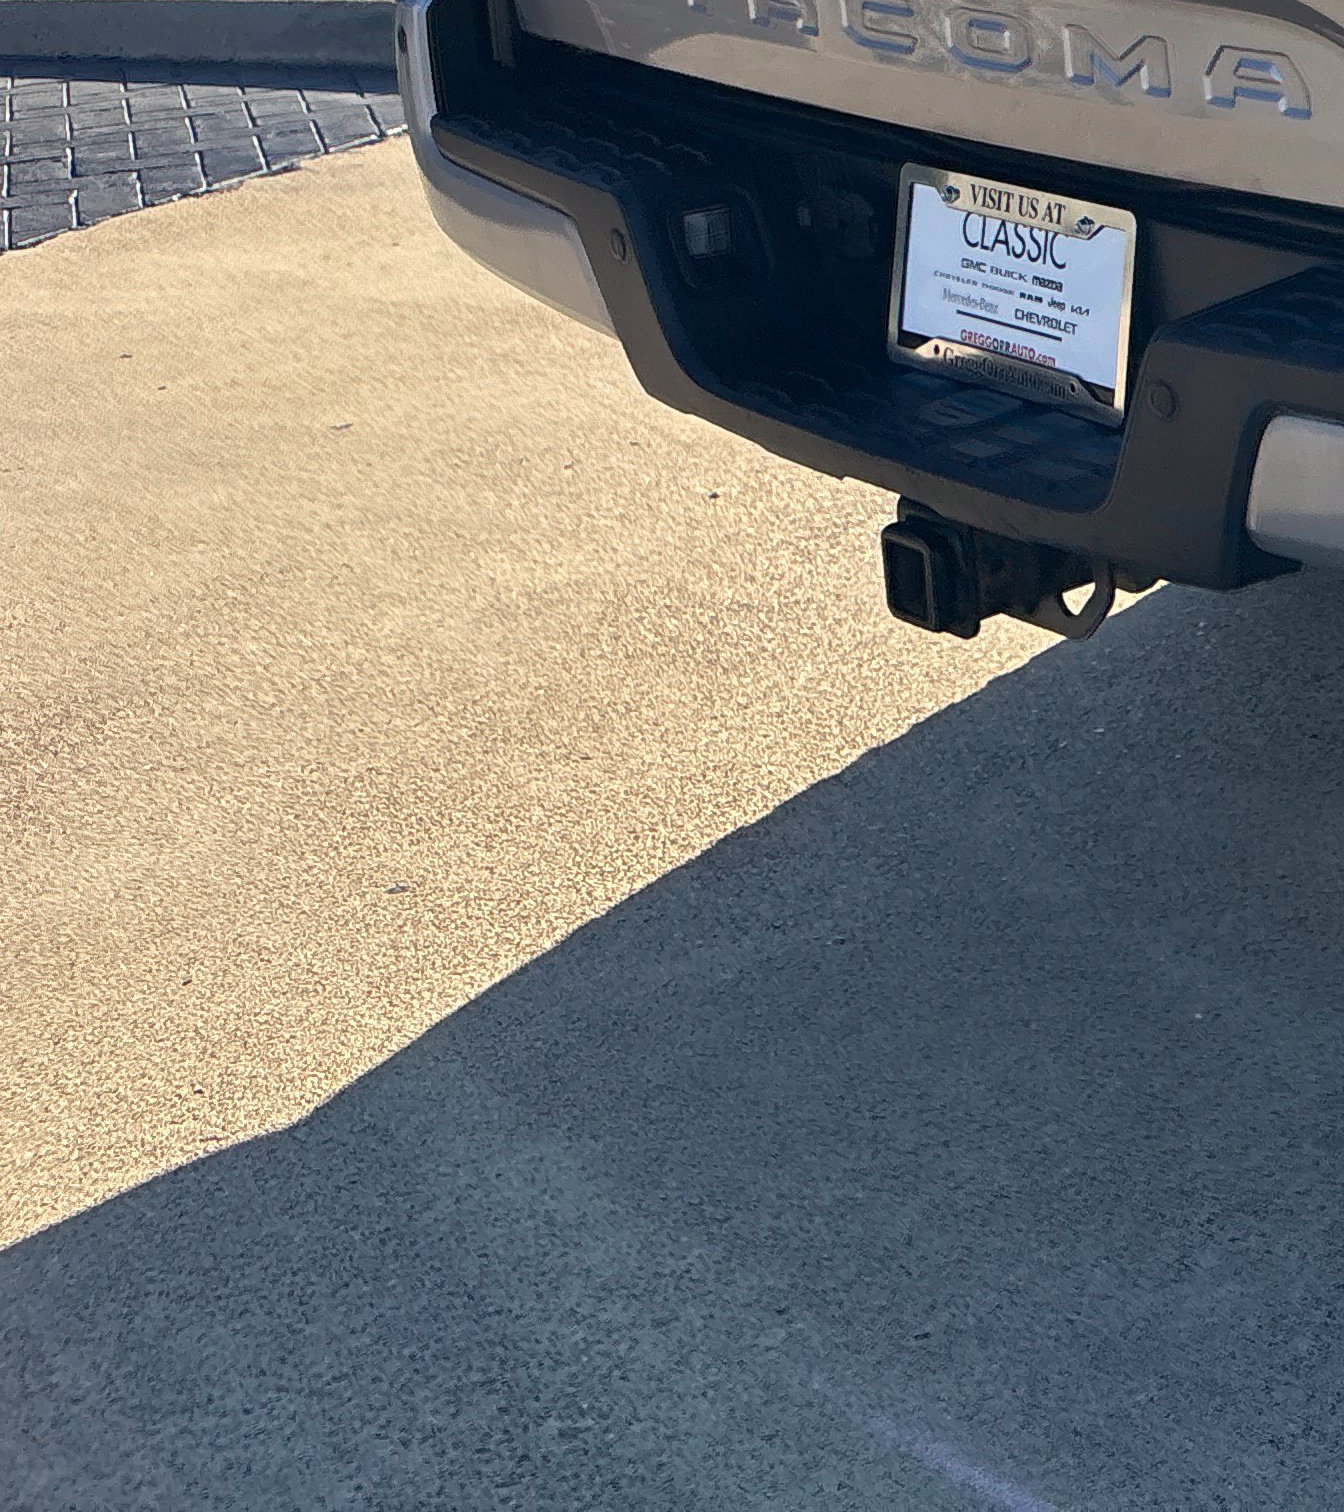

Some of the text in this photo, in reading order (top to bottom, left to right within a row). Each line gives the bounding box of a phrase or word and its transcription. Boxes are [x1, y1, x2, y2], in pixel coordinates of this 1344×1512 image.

[970, 183, 1067, 225] VISIT US AT
[962, 211, 1067, 270] CLASSIC
[933, 270, 979, 287] CHRYSLER
[1019, 291, 1044, 304] RAM
[1047, 296, 1066, 312] Jeep
[961, 257, 987, 274] GMC
[989, 265, 1028, 283] BUICK
[1013, 307, 1078, 336] CHEVROLET
